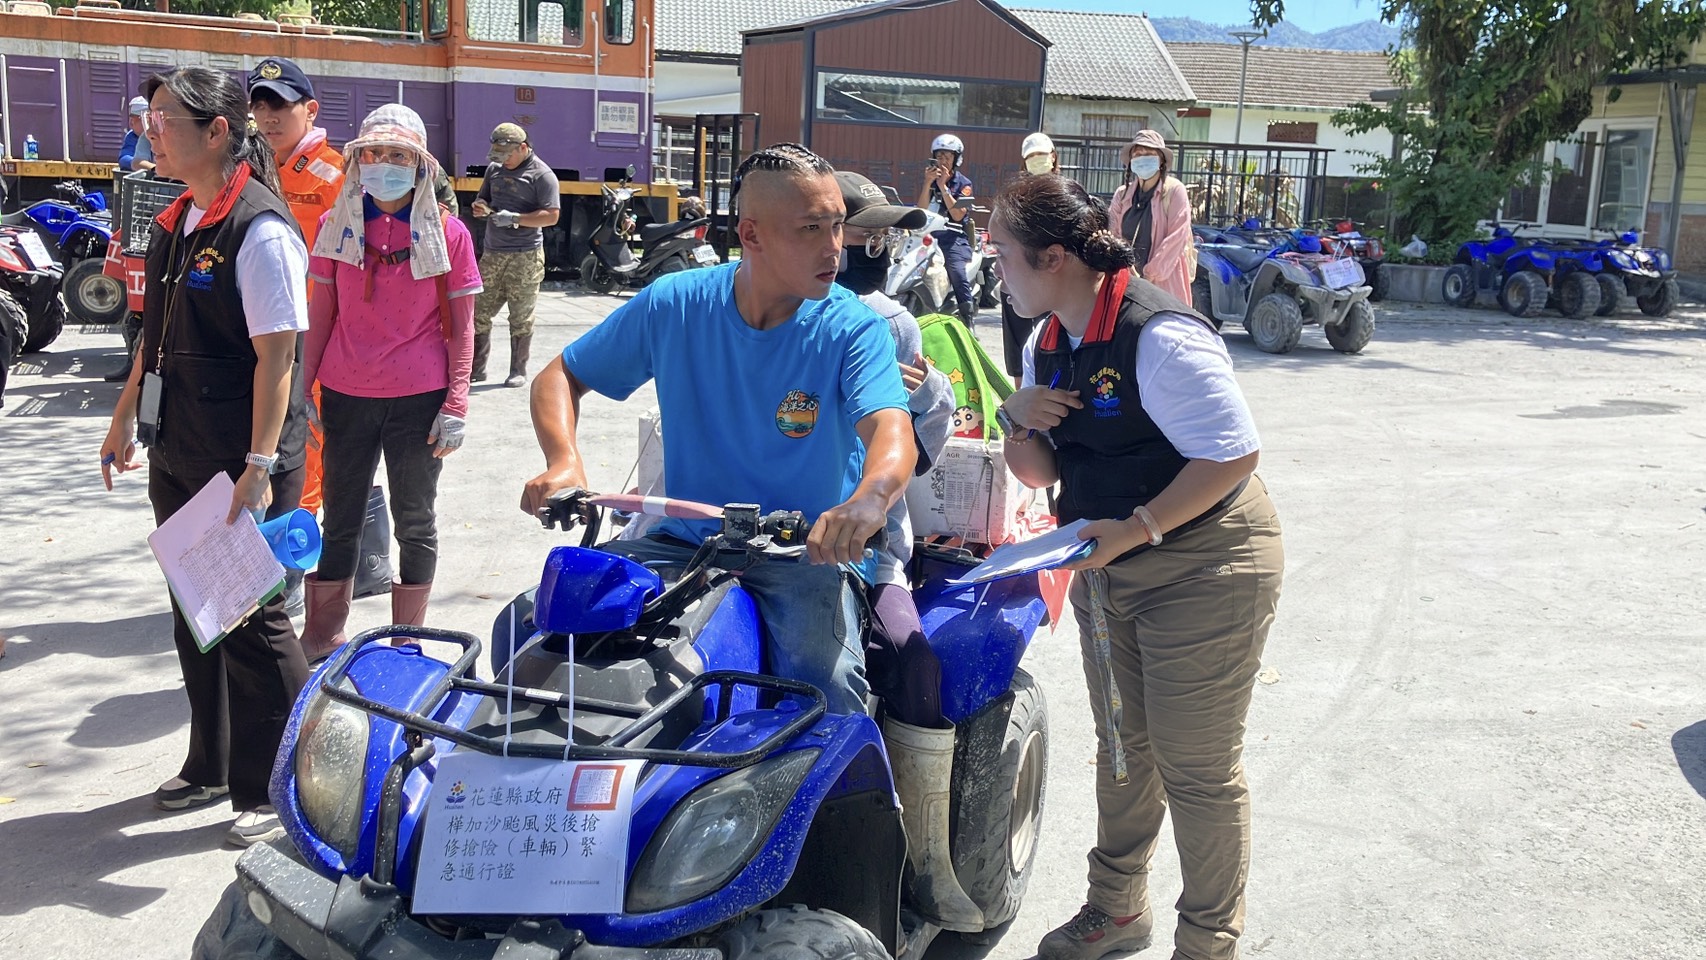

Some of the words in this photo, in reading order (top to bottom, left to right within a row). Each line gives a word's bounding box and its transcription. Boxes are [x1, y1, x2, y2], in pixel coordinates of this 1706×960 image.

[520, 88, 532, 101] 18
[470, 786, 563, 807] 花蓮縣政府
[446, 813, 601, 834] 樺加沙颱風災後搶
[439, 862, 516, 882] 急通行證
